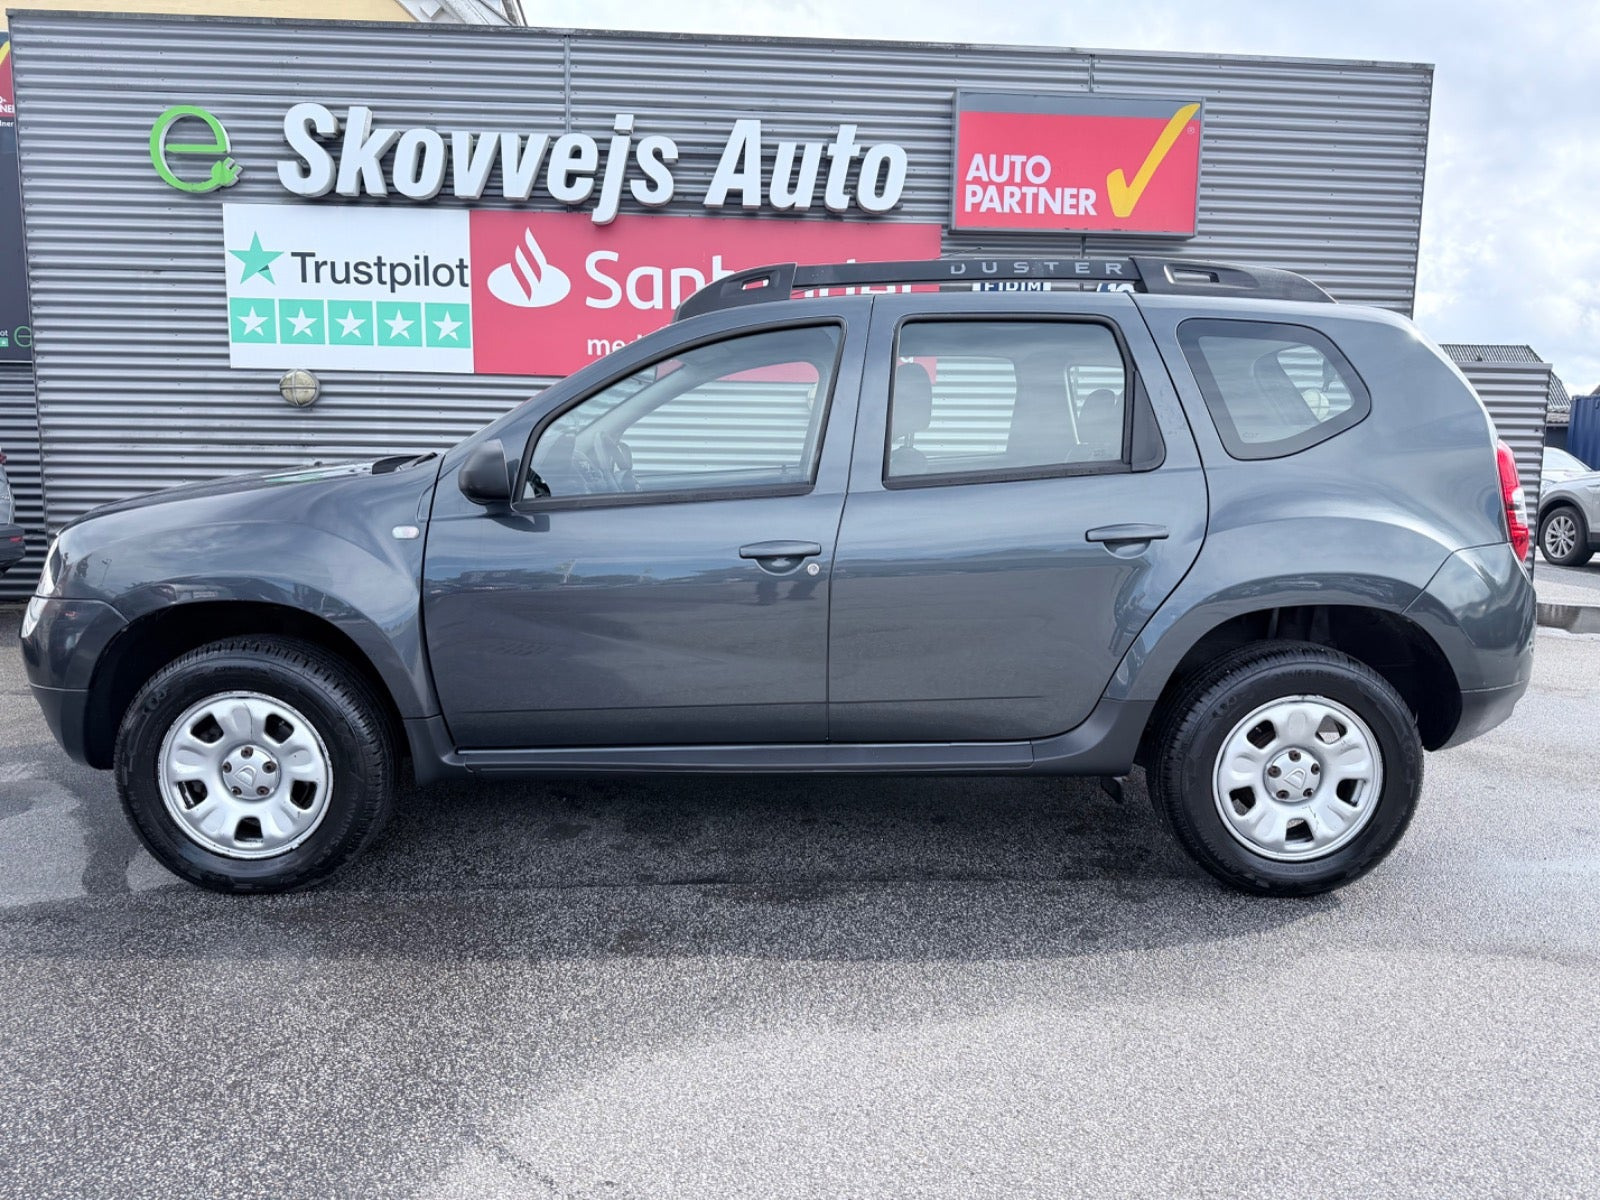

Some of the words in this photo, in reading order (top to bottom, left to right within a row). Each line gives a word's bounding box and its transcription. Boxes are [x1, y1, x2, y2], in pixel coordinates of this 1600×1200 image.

[277, 102, 680, 225] Skovvejs
[703, 119, 908, 214] Auto
[965, 153, 1051, 184] AUTO
[964, 185, 1098, 216] PARTNER
[290, 251, 470, 293] Trustpilot
[950, 262, 1123, 275] DUSTER
